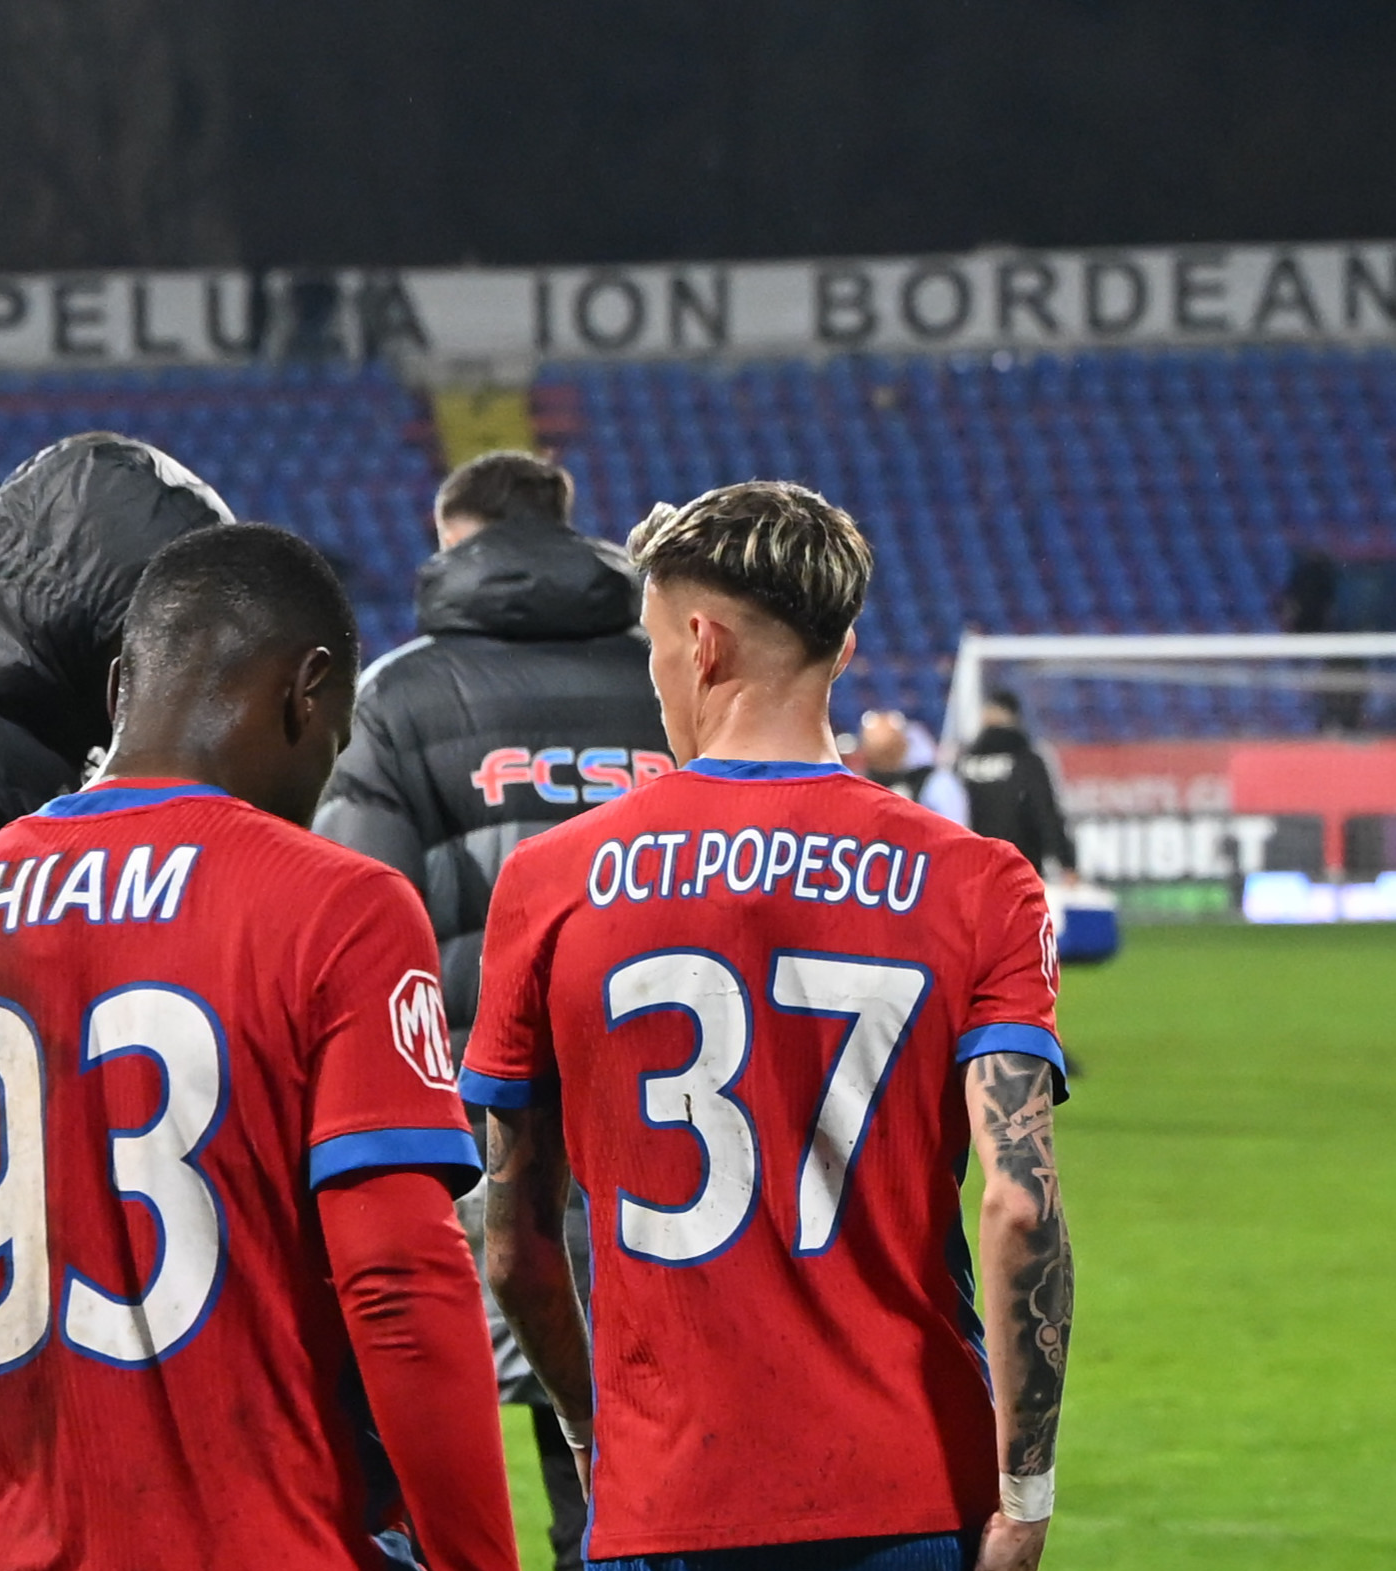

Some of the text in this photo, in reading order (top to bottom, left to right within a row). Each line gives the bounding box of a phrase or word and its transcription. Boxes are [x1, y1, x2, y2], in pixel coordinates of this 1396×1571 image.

[531, 268, 731, 352] ION
[814, 252, 1396, 345] BORDEAN
[587, 825, 931, 916] OCT.POPESCU
[602, 946, 934, 1269] 37
